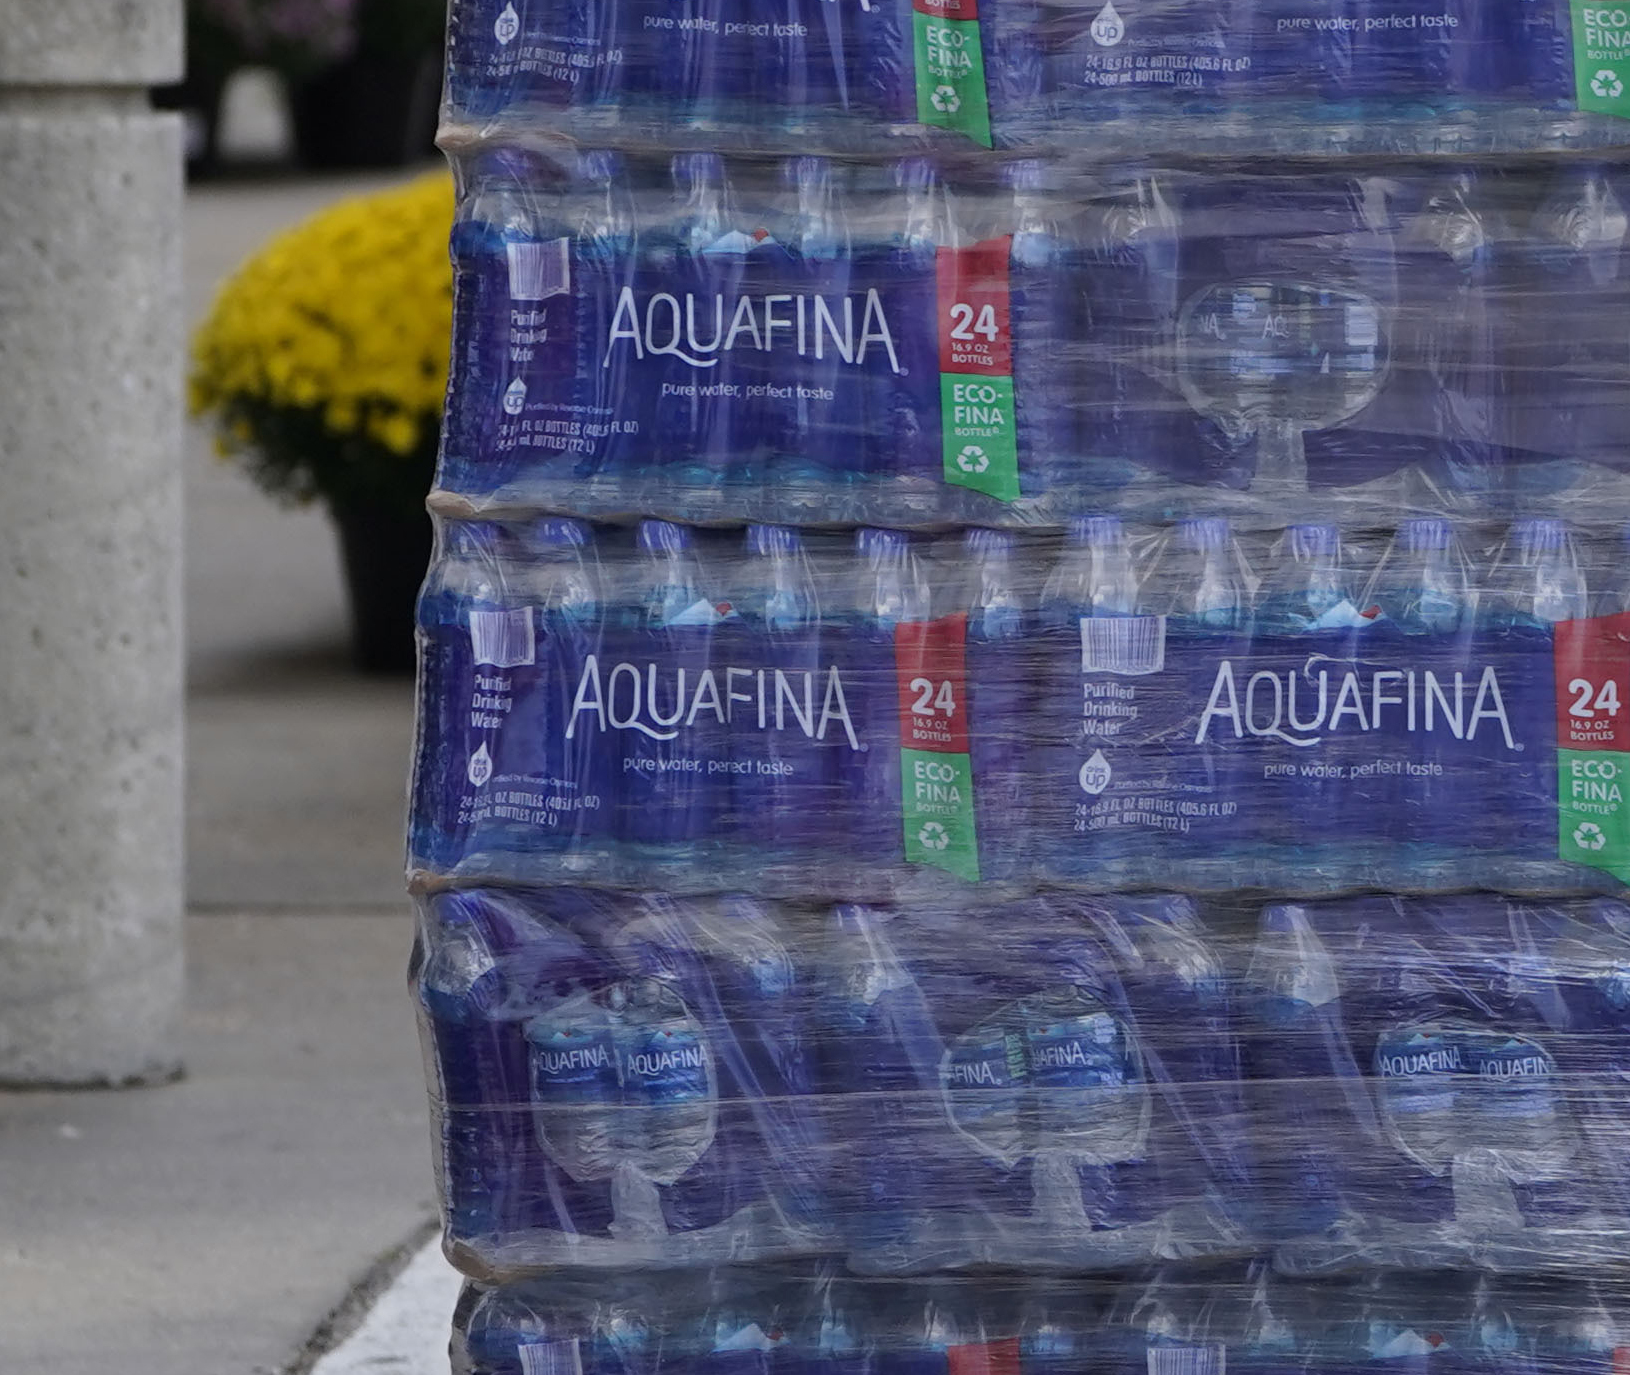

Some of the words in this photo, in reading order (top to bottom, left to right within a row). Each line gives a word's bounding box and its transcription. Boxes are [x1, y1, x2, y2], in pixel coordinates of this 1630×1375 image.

[643, 15, 674, 29] pure
[678, 17, 720, 35] water,
[773, 22, 808, 36] taste
[1277, 16, 1311, 32] pure
[1314, 16, 1360, 32] water,
[1364, 12, 1416, 32] perfect
[1419, 13, 1459, 29] taste
[926, 45, 973, 68] FINA
[603, 286, 900, 373] AQUAFINA
[950, 302, 999, 343] 24
[952, 342, 973, 354] 16.9
[975, 343, 990, 354] OZ
[952, 353, 994, 366] BOTTLES
[661, 382, 695, 398] pure
[698, 382, 741, 398] water,
[745, 383, 793, 401] perfect
[796, 386, 835, 401] taste
[954, 405, 1005, 425] FINA
[910, 677, 956, 717] 24
[1083, 682, 1135, 700] Purified
[1568, 677, 1621, 718] 24
[565, 654, 860, 751] AQUAFINA
[1083, 701, 1139, 720] Drinking
[1194, 660, 1515, 750] AQUAFINA
[912, 728, 952, 742] BOTTLES
[1083, 719, 1122, 736] Water
[1570, 719, 1592, 731] 16.9
[1594, 719, 1610, 730] OZ
[1570, 729, 1615, 742] BOTTLES
[623, 756, 656, 772] pure
[658, 757, 703, 774] water,
[756, 760, 794, 776] taste
[1263, 761, 1297, 779] pure
[1300, 762, 1346, 780] water,
[1350, 758, 1401, 780] perfect
[1405, 760, 1443, 777] taste
[914, 782, 962, 804] FINA
[1572, 780, 1623, 803] FINA
[1480, 1056, 1552, 1082] AQUAFIN
